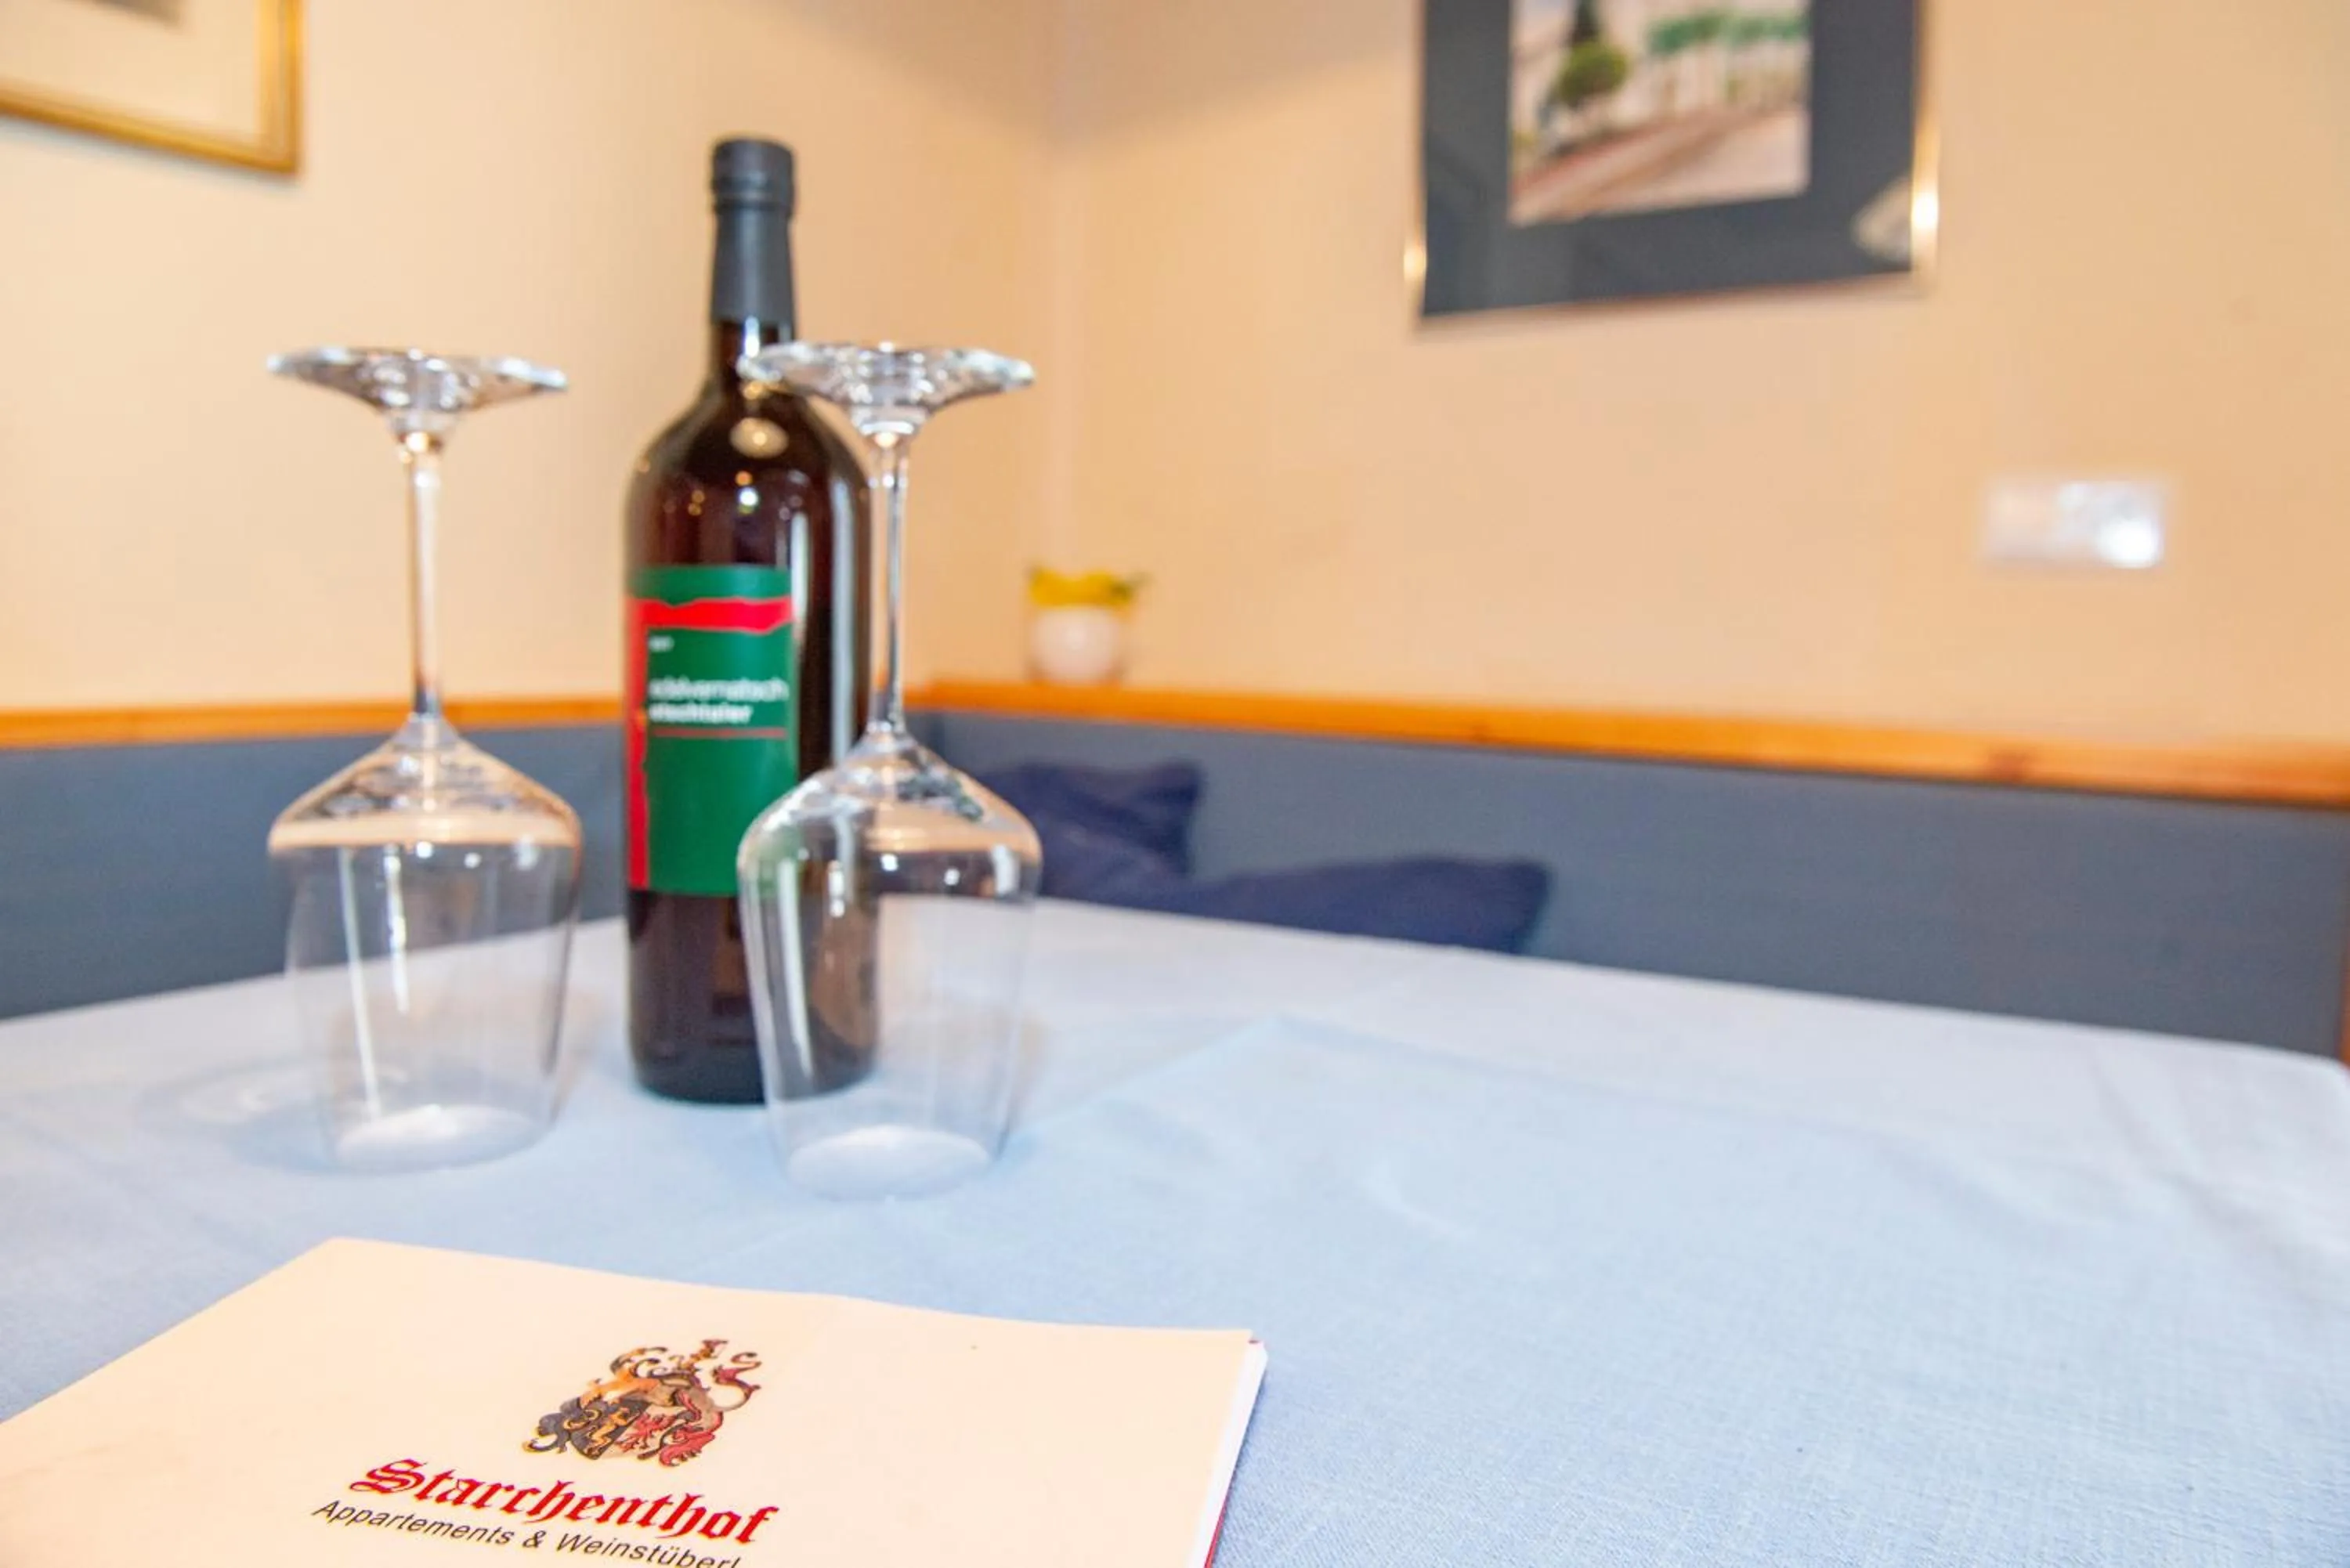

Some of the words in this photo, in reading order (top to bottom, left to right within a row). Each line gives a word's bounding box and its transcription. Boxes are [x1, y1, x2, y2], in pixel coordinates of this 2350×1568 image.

[312, 1499, 515, 1545] Appartements
[522, 1530, 548, 1549] &
[350, 1458, 779, 1544] Starchenthof
